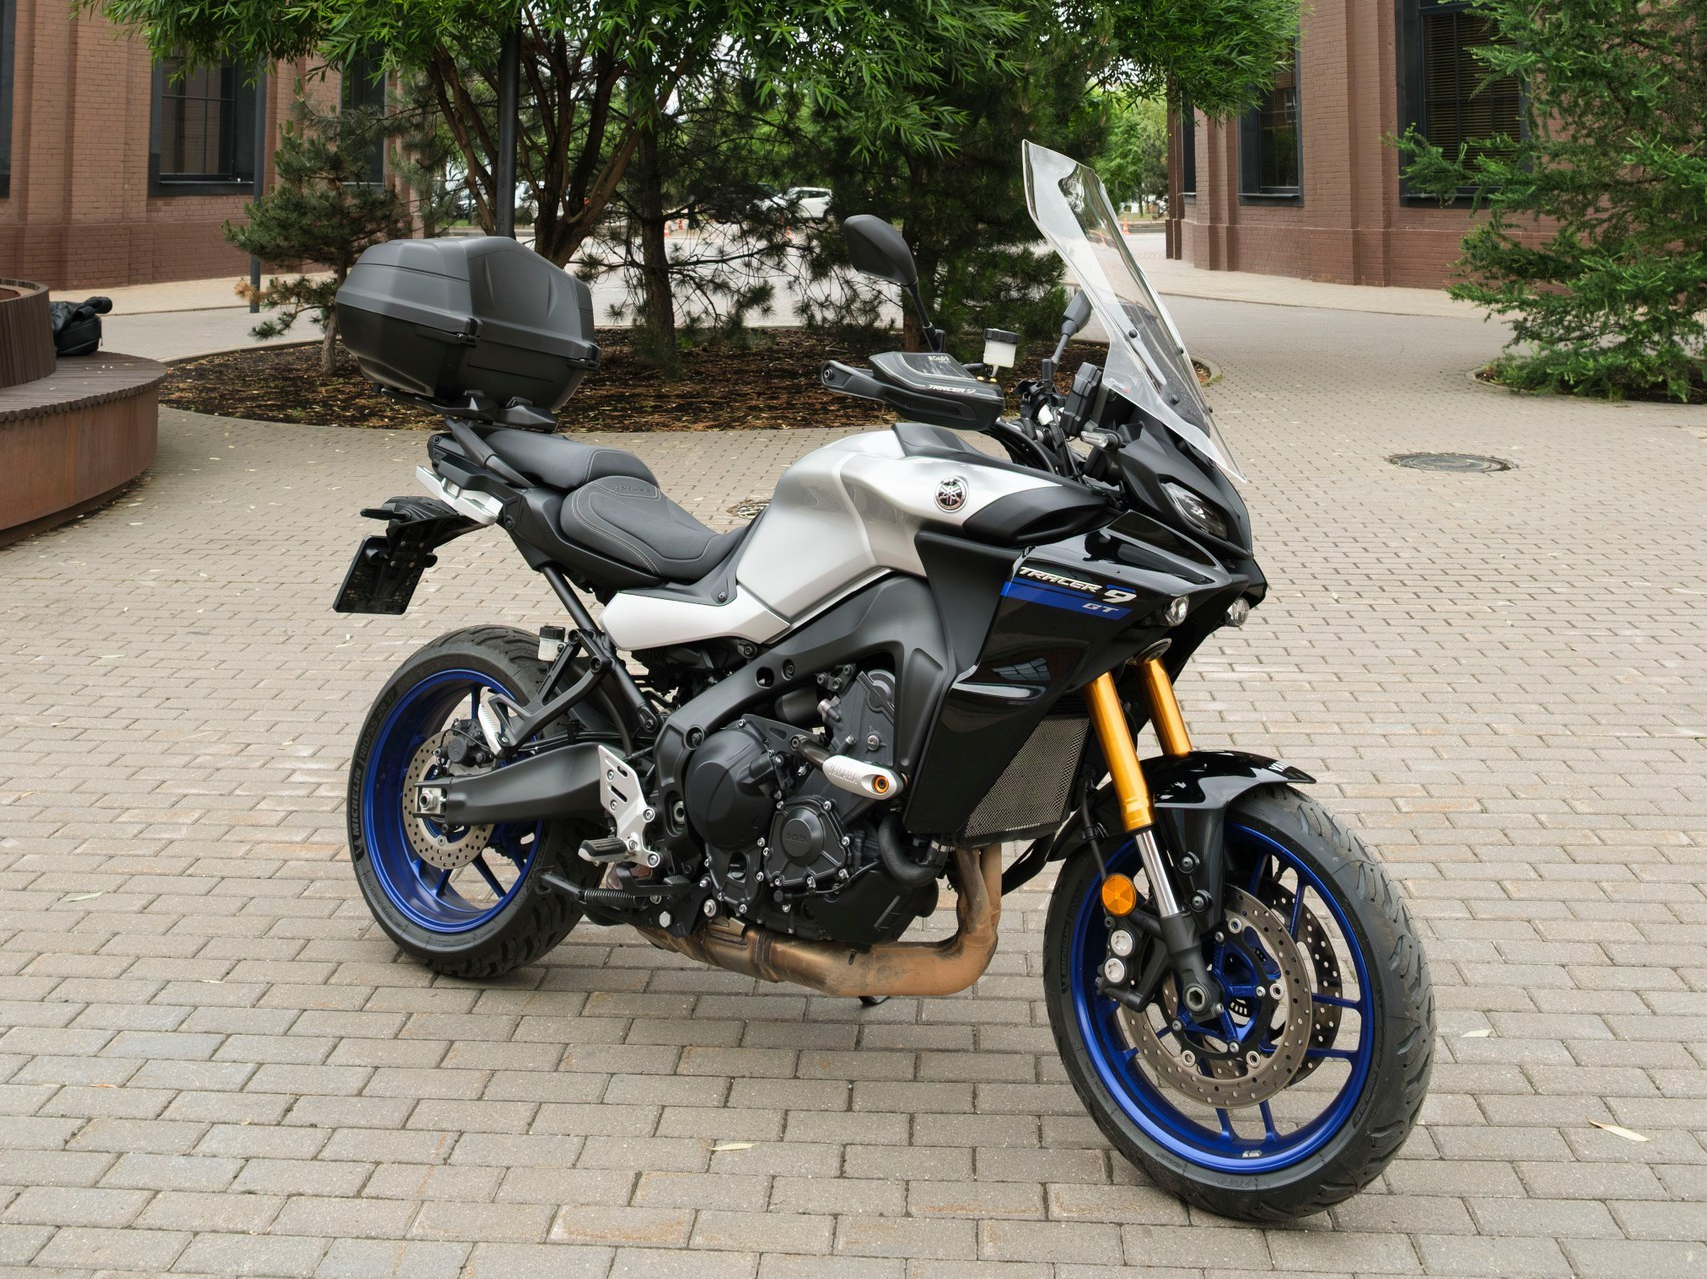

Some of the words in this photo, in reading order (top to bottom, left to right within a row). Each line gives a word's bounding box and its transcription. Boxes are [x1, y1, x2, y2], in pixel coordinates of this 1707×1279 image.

[1018, 566, 1103, 593] TRACER
[1102, 589, 1137, 604] 9
[1082, 603, 1120, 613] GT
[351, 768, 362, 836] MICHELIN
[358, 720, 378, 761] 180/55
